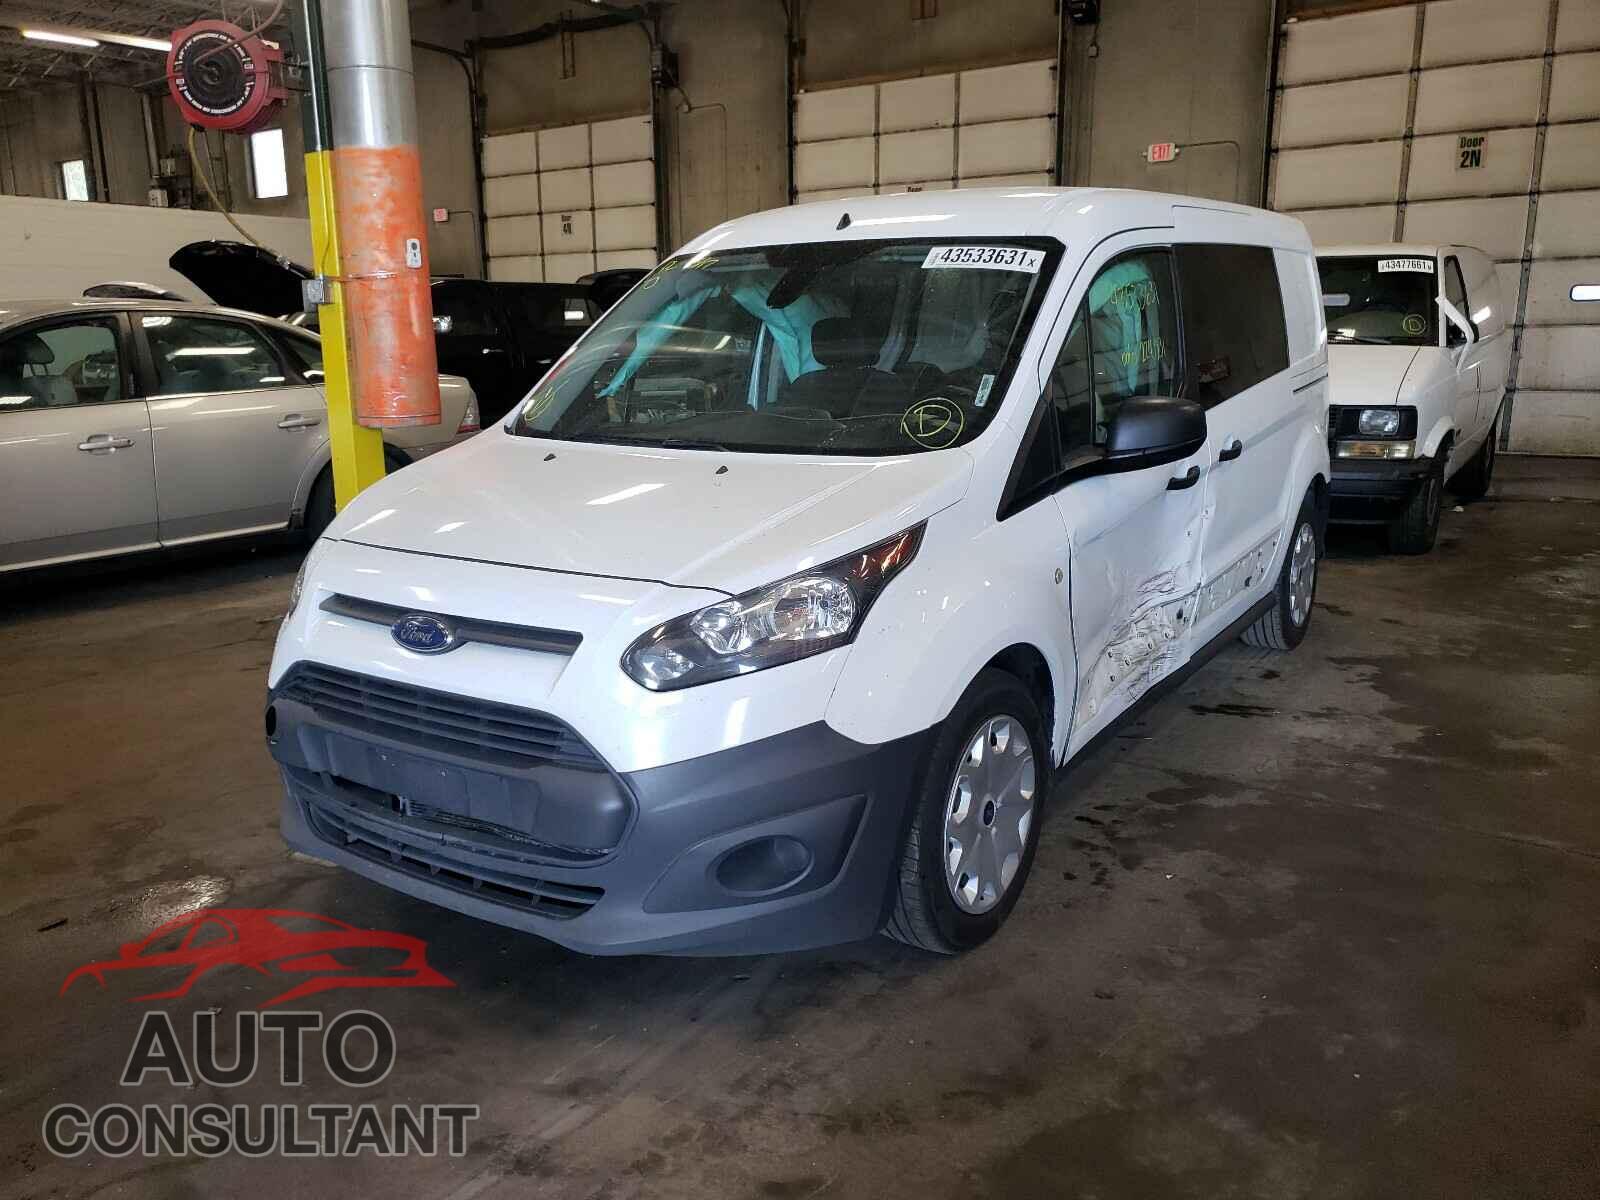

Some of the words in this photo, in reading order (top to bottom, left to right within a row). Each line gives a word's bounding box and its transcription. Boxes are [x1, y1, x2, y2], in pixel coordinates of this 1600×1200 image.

[1151, 144, 1172, 160] EXIT
[1460, 149, 1481, 168] 2N
[940, 248, 1028, 266] 43533631
[400, 621, 435, 644] Ford
